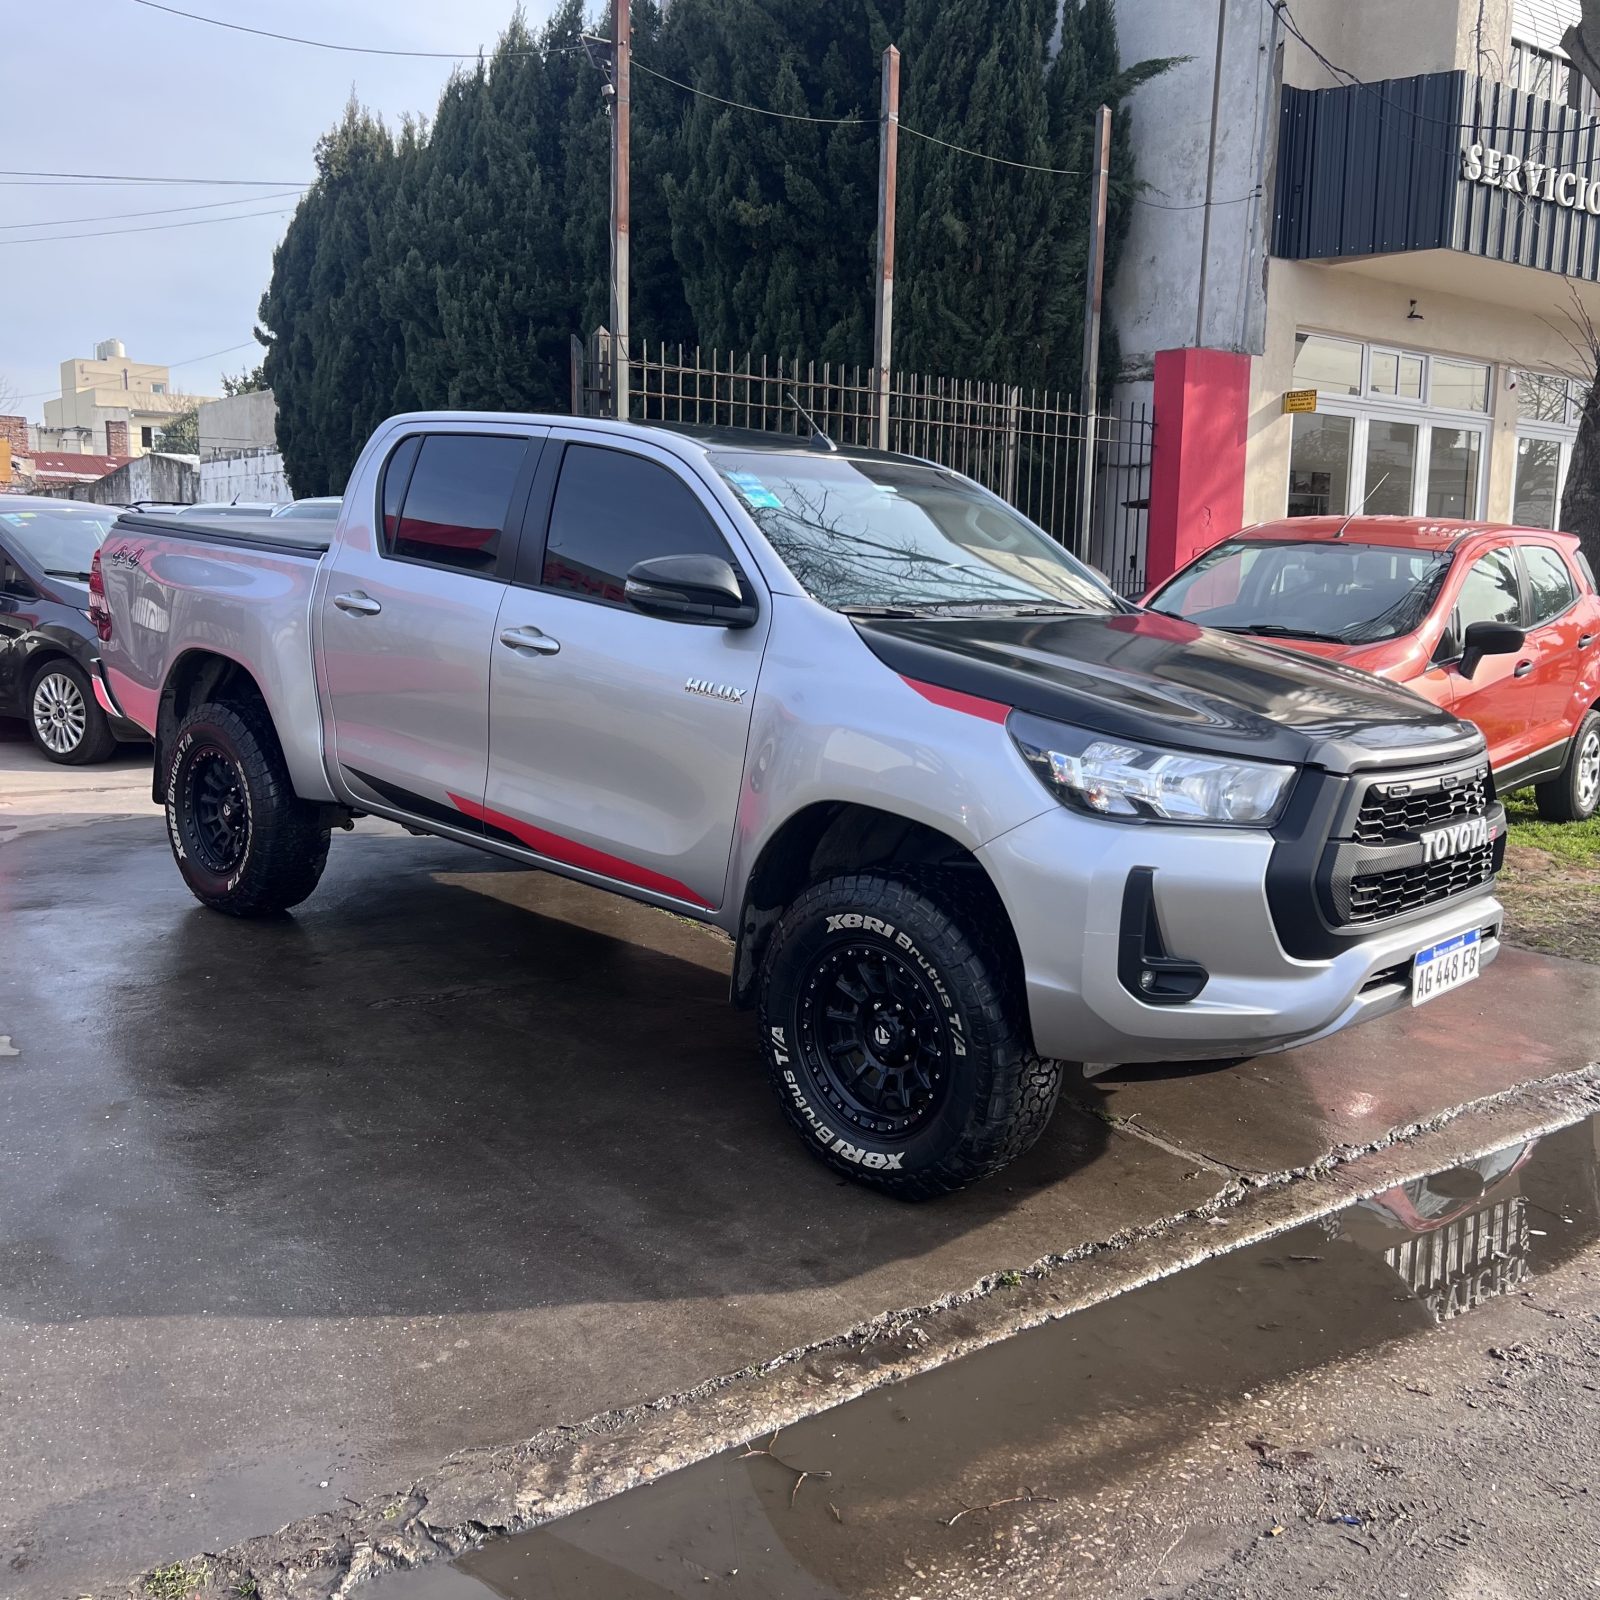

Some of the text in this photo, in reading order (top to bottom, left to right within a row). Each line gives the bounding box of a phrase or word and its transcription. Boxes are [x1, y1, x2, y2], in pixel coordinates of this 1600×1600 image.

[685, 677, 748, 704] HILUX
[167, 733, 194, 860] XBRI Brutus T/A
[1420, 817, 1489, 863] TOYOTA
[825, 913, 967, 1057] XBRI Brutus T/A
[1416, 964, 1433, 999] AG
[1436, 954, 1459, 988] 448
[771, 1026, 906, 1171] XBRI Brutus T/A
